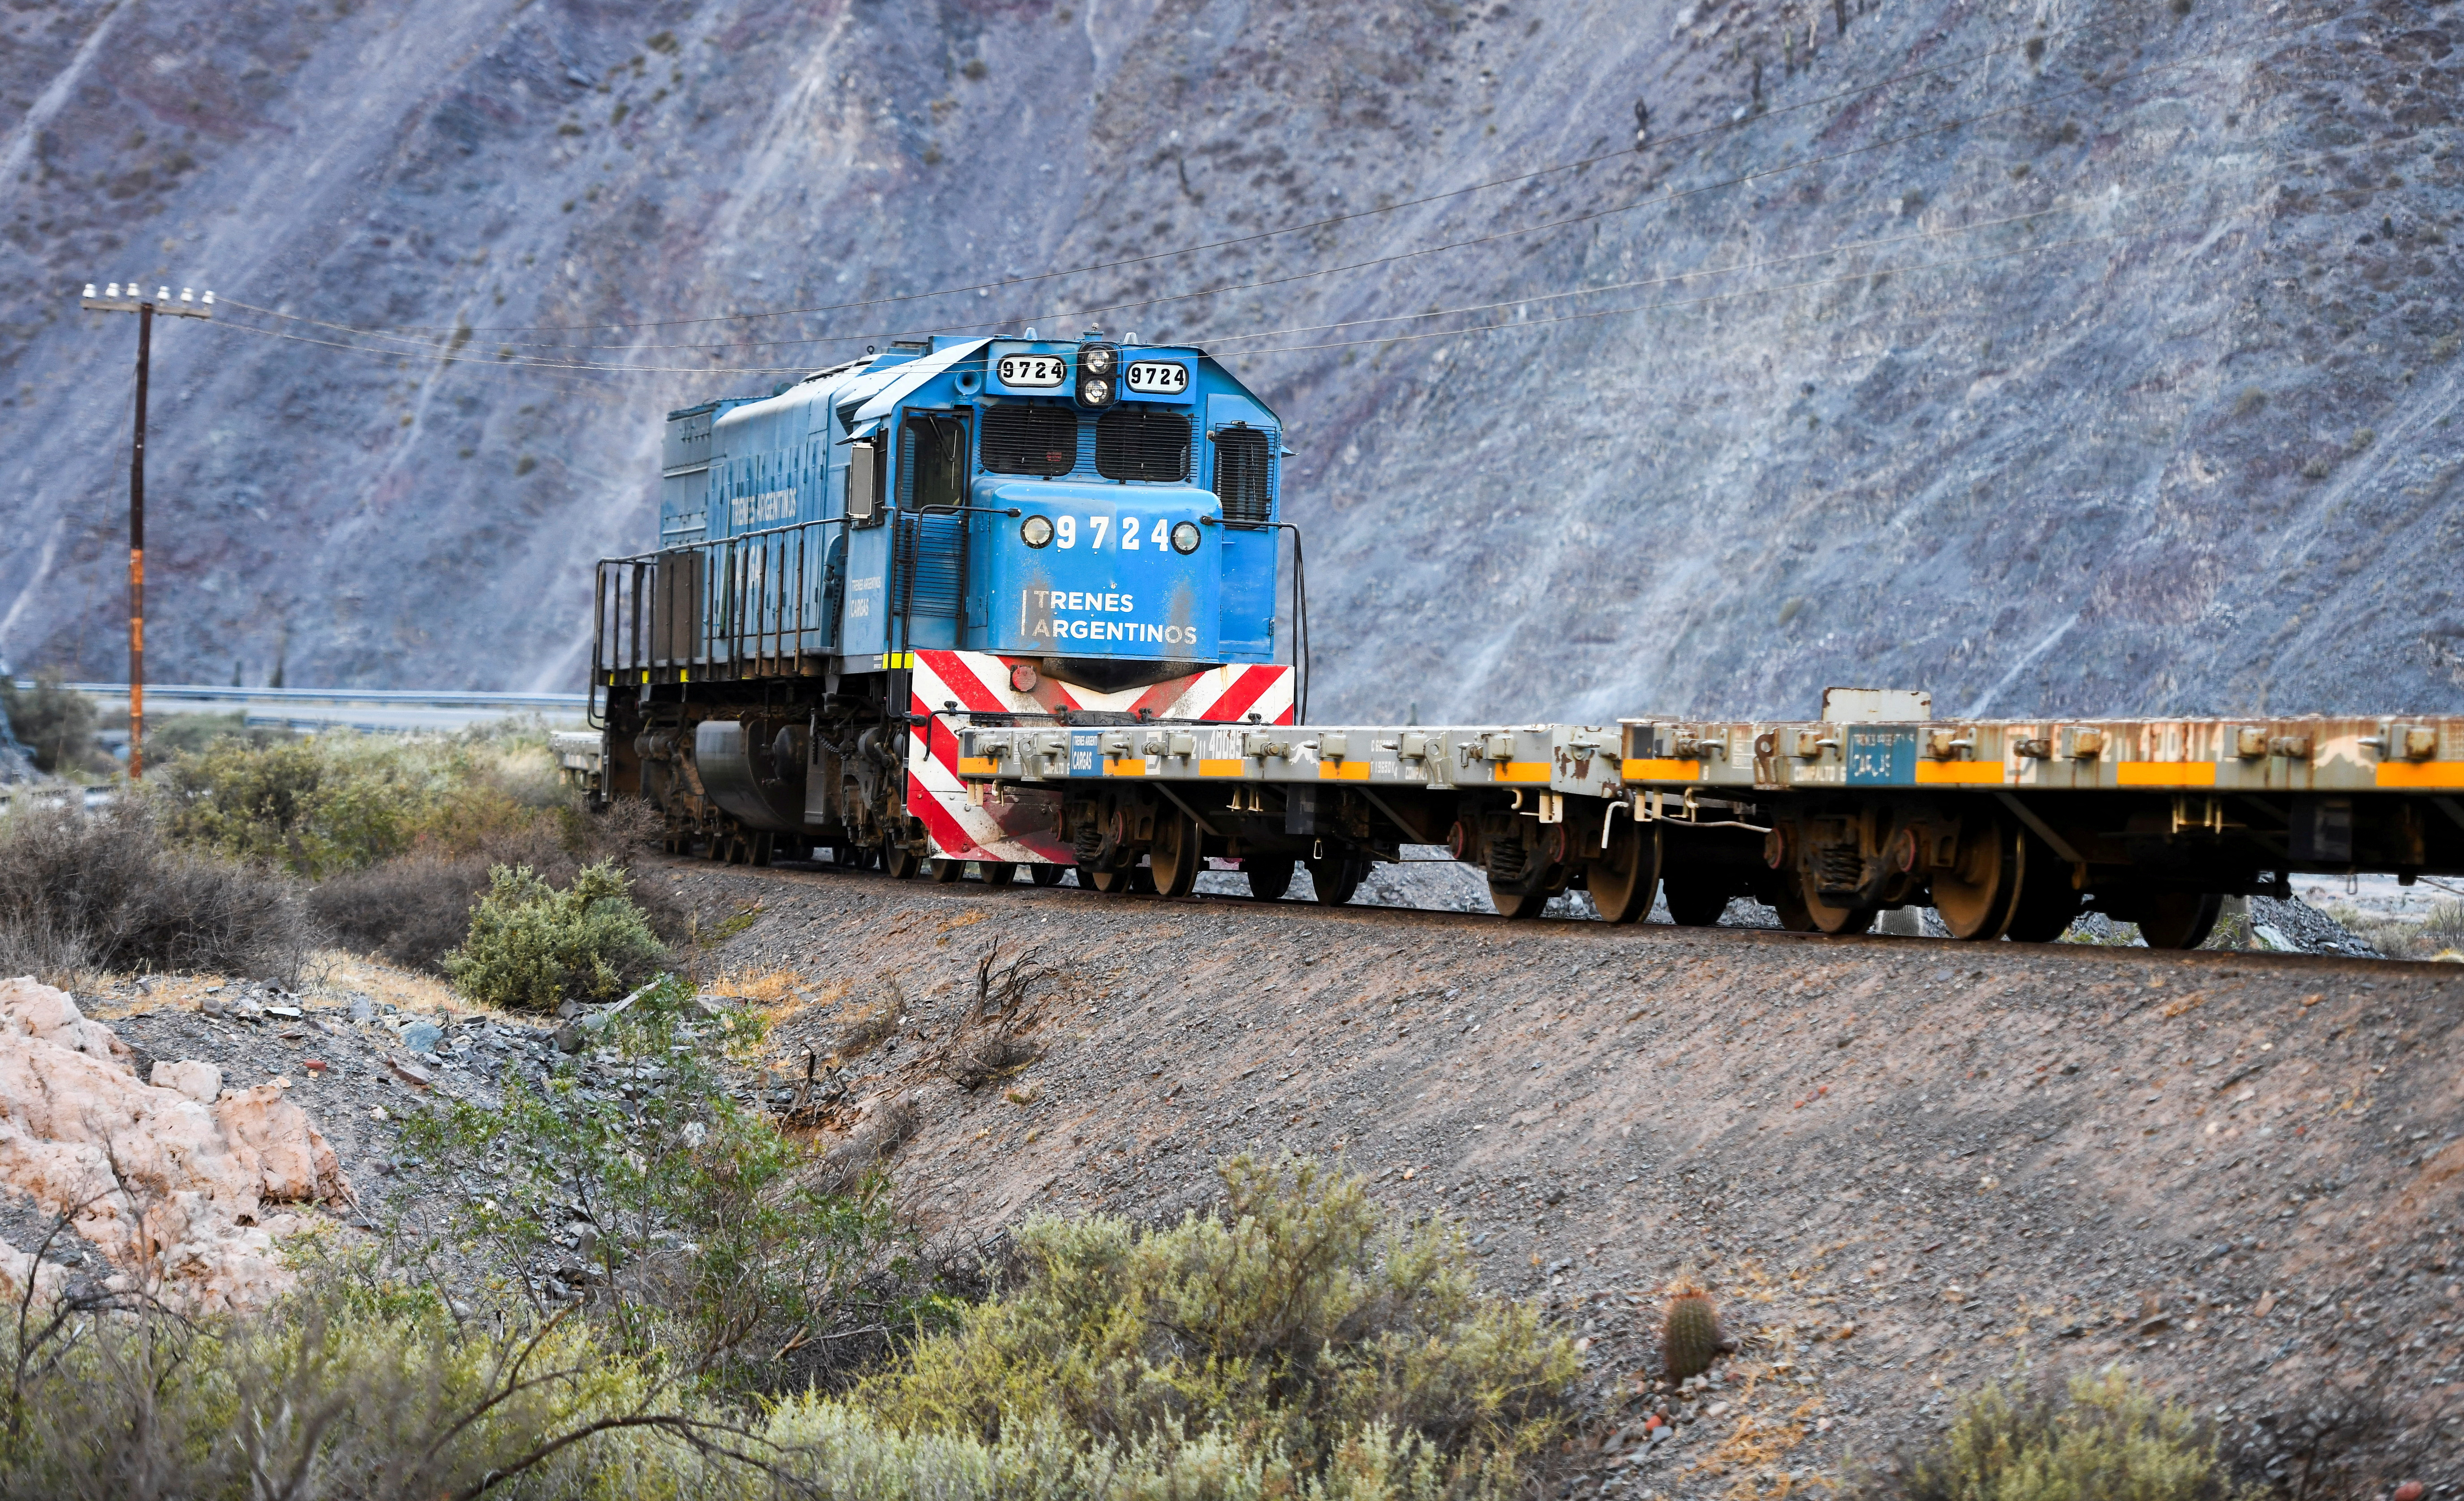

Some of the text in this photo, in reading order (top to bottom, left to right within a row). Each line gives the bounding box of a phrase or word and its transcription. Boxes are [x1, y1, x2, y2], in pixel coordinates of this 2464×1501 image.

[1004, 361, 1062, 378] 9724
[1131, 367, 1184, 386] 9724
[732, 487, 797, 526] TRENES ARGENTINOS
[1057, 515, 1168, 552] 9724
[851, 598, 869, 618] CARGAS
[1034, 590, 1133, 612] TRENES
[1032, 619, 1197, 645] ARGENTINOS
[1074, 735, 1085, 746] TRENES
[1073, 751, 1092, 770] CARGAS
